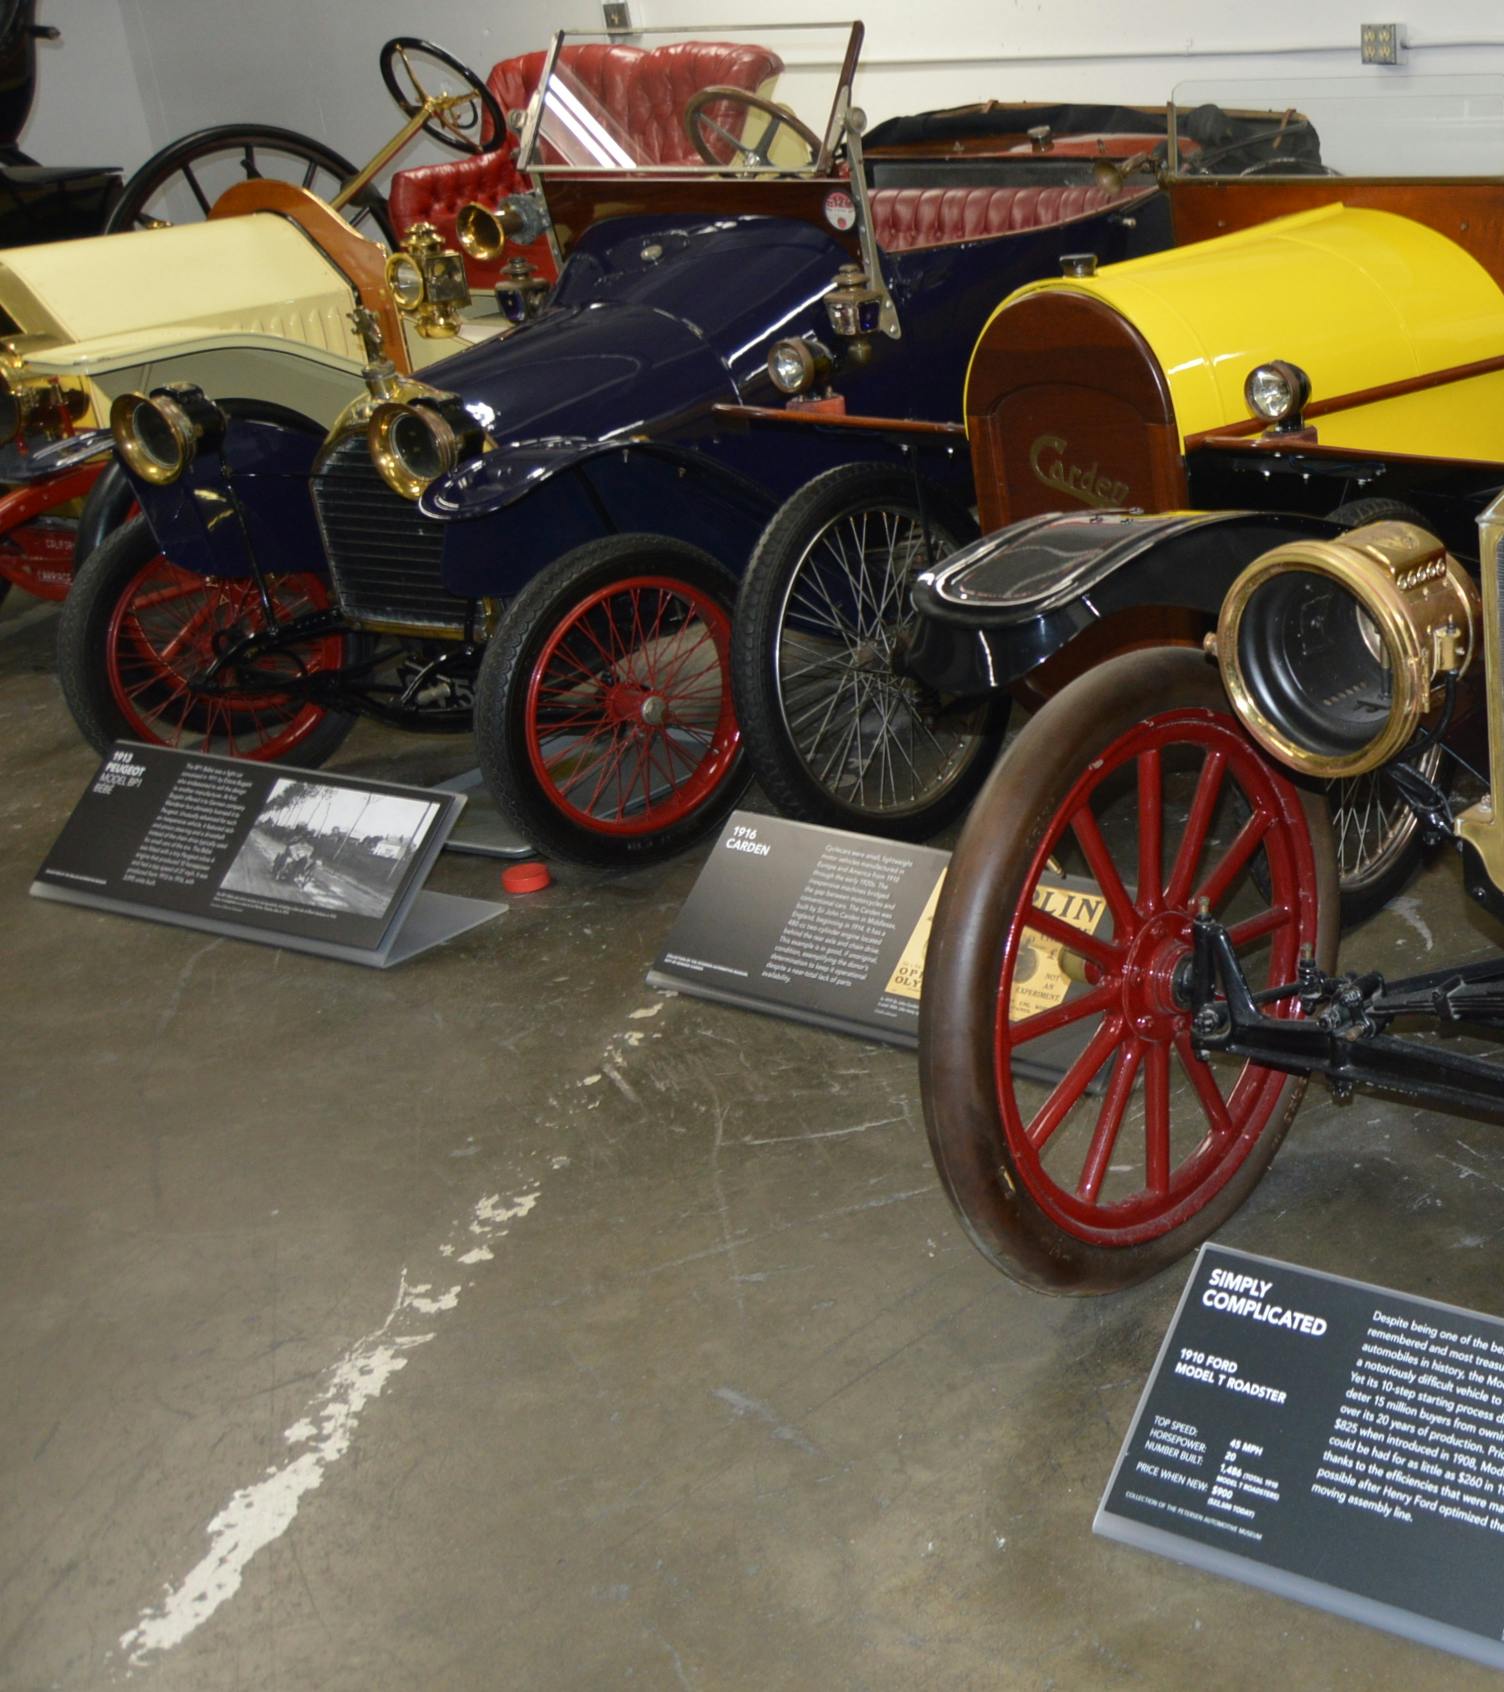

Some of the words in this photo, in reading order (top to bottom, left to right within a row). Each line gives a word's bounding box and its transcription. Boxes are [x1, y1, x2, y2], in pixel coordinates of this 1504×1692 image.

[1030, 436, 1129, 508] Carden
[100, 772, 126, 785] MODEL
[105, 761, 146, 776] PEUGEOT
[726, 838, 771, 856] CARDEN
[733, 826, 757, 840] 1916
[1016, 987, 1060, 1001] EXPERIMENT
[1209, 1269, 1272, 1298] SIMPLY
[1202, 1290, 1327, 1336] COMPLICATED
[1373, 1310, 1409, 1329] Despite
[1410, 1320, 1438, 1339] being
[1439, 1331, 1458, 1342] one
[1460, 1335, 1472, 1345] of
[1472, 1337, 1489, 1350] the
[1180, 1348, 1204, 1364] 1910
[1206, 1355, 1238, 1373] FORD
[1362, 1343, 1419, 1365] automobiles
[1420, 1357, 1430, 1368] in
[1431, 1359, 1465, 1379] history,
[1468, 1370, 1485, 1383] the
[1367, 1328, 1428, 1351] remembered
[1428, 1345, 1448, 1356] and
[1449, 1350, 1474, 1363] most
[1175, 1362, 1214, 1384] MODEL
[1218, 1375, 1226, 1386] T
[1227, 1378, 1286, 1404] ROADSTER
[1351, 1371, 1365, 1385] Yet
[1366, 1376, 1378, 1388] its
[1382, 1380, 1416, 1400] 10-step
[1417, 1393, 1455, 1412] starting
[1455, 1404, 1494, 1421] process
[1356, 1358, 1363, 1367] a
[1364, 1361, 1417, 1384] notoriously
[1418, 1374, 1454, 1392] difficult
[1456, 1386, 1489, 1402] vehicle
[1491, 1394, 1502, 1405] to
[1340, 1405, 1361, 1417] over
[1362, 1409, 1374, 1422] its
[1376, 1413, 1390, 1426] 20
[1389, 1420, 1415, 1433] years
[1417, 1426, 1430, 1437] of
[1428, 1431, 1484, 1454] production.
[1346, 1388, 1372, 1403] deter
[1375, 1395, 1385, 1407] 15
[1386, 1401, 1417, 1416] million
[1419, 1407, 1451, 1426] buyers
[1453, 1417, 1476, 1433] from
[1145, 1441, 1178, 1458] NUMBER
[1180, 1451, 1204, 1466] BUILT:
[1150, 1429, 1207, 1452] HORSEPOWER:
[1224, 1451, 1237, 1462] 20
[1154, 1415, 1170, 1427] TOP
[1171, 1422, 1198, 1438] SPEED:
[1230, 1439, 1242, 1450] 45
[1242, 1442, 1263, 1456] MPH
[1334, 1418, 1358, 1434] $825
[1360, 1427, 1385, 1442] when
[1386, 1433, 1440, 1458] introduced
[1440, 1449, 1450, 1461] in
[1453, 1453, 1477, 1471] 1908,
[1136, 1461, 1160, 1476] PRICE
[1161, 1470, 1185, 1486] WHEN
[1187, 1477, 1209, 1492] NEW:
[1211, 1486, 1233, 1500] $900
[1216, 1475, 1237, 1488] MODEL
[1323, 1450, 1353, 1468] thanks
[1355, 1460, 1366, 1471] to
[1368, 1463, 1384, 1477] the
[1386, 1469, 1438, 1493] efficiencies
[1441, 1485, 1461, 1501] that
[1463, 1494, 1487, 1508] were
[1329, 1437, 1356, 1451] could
[1356, 1441, 1370, 1455] be
[1371, 1446, 1391, 1461] had
[1392, 1452, 1406, 1465] for
[1407, 1460, 1418, 1470] as
[1420, 1460, 1443, 1477] little
[1444, 1471, 1456, 1480] as
[1457, 1472, 1483, 1488] $260
[1484, 1480, 1494, 1492] in
[1311, 1484, 1347, 1504] moving
[1348, 1495, 1392, 1517] assembly
[1393, 1506, 1413, 1522] line.
[1316, 1468, 1356, 1486] possible
[1358, 1479, 1382, 1494] after
[1383, 1485, 1412, 1505] Henry
[1414, 1494, 1438, 1511] Ford
[1439, 1505, 1489, 1527] optimized
